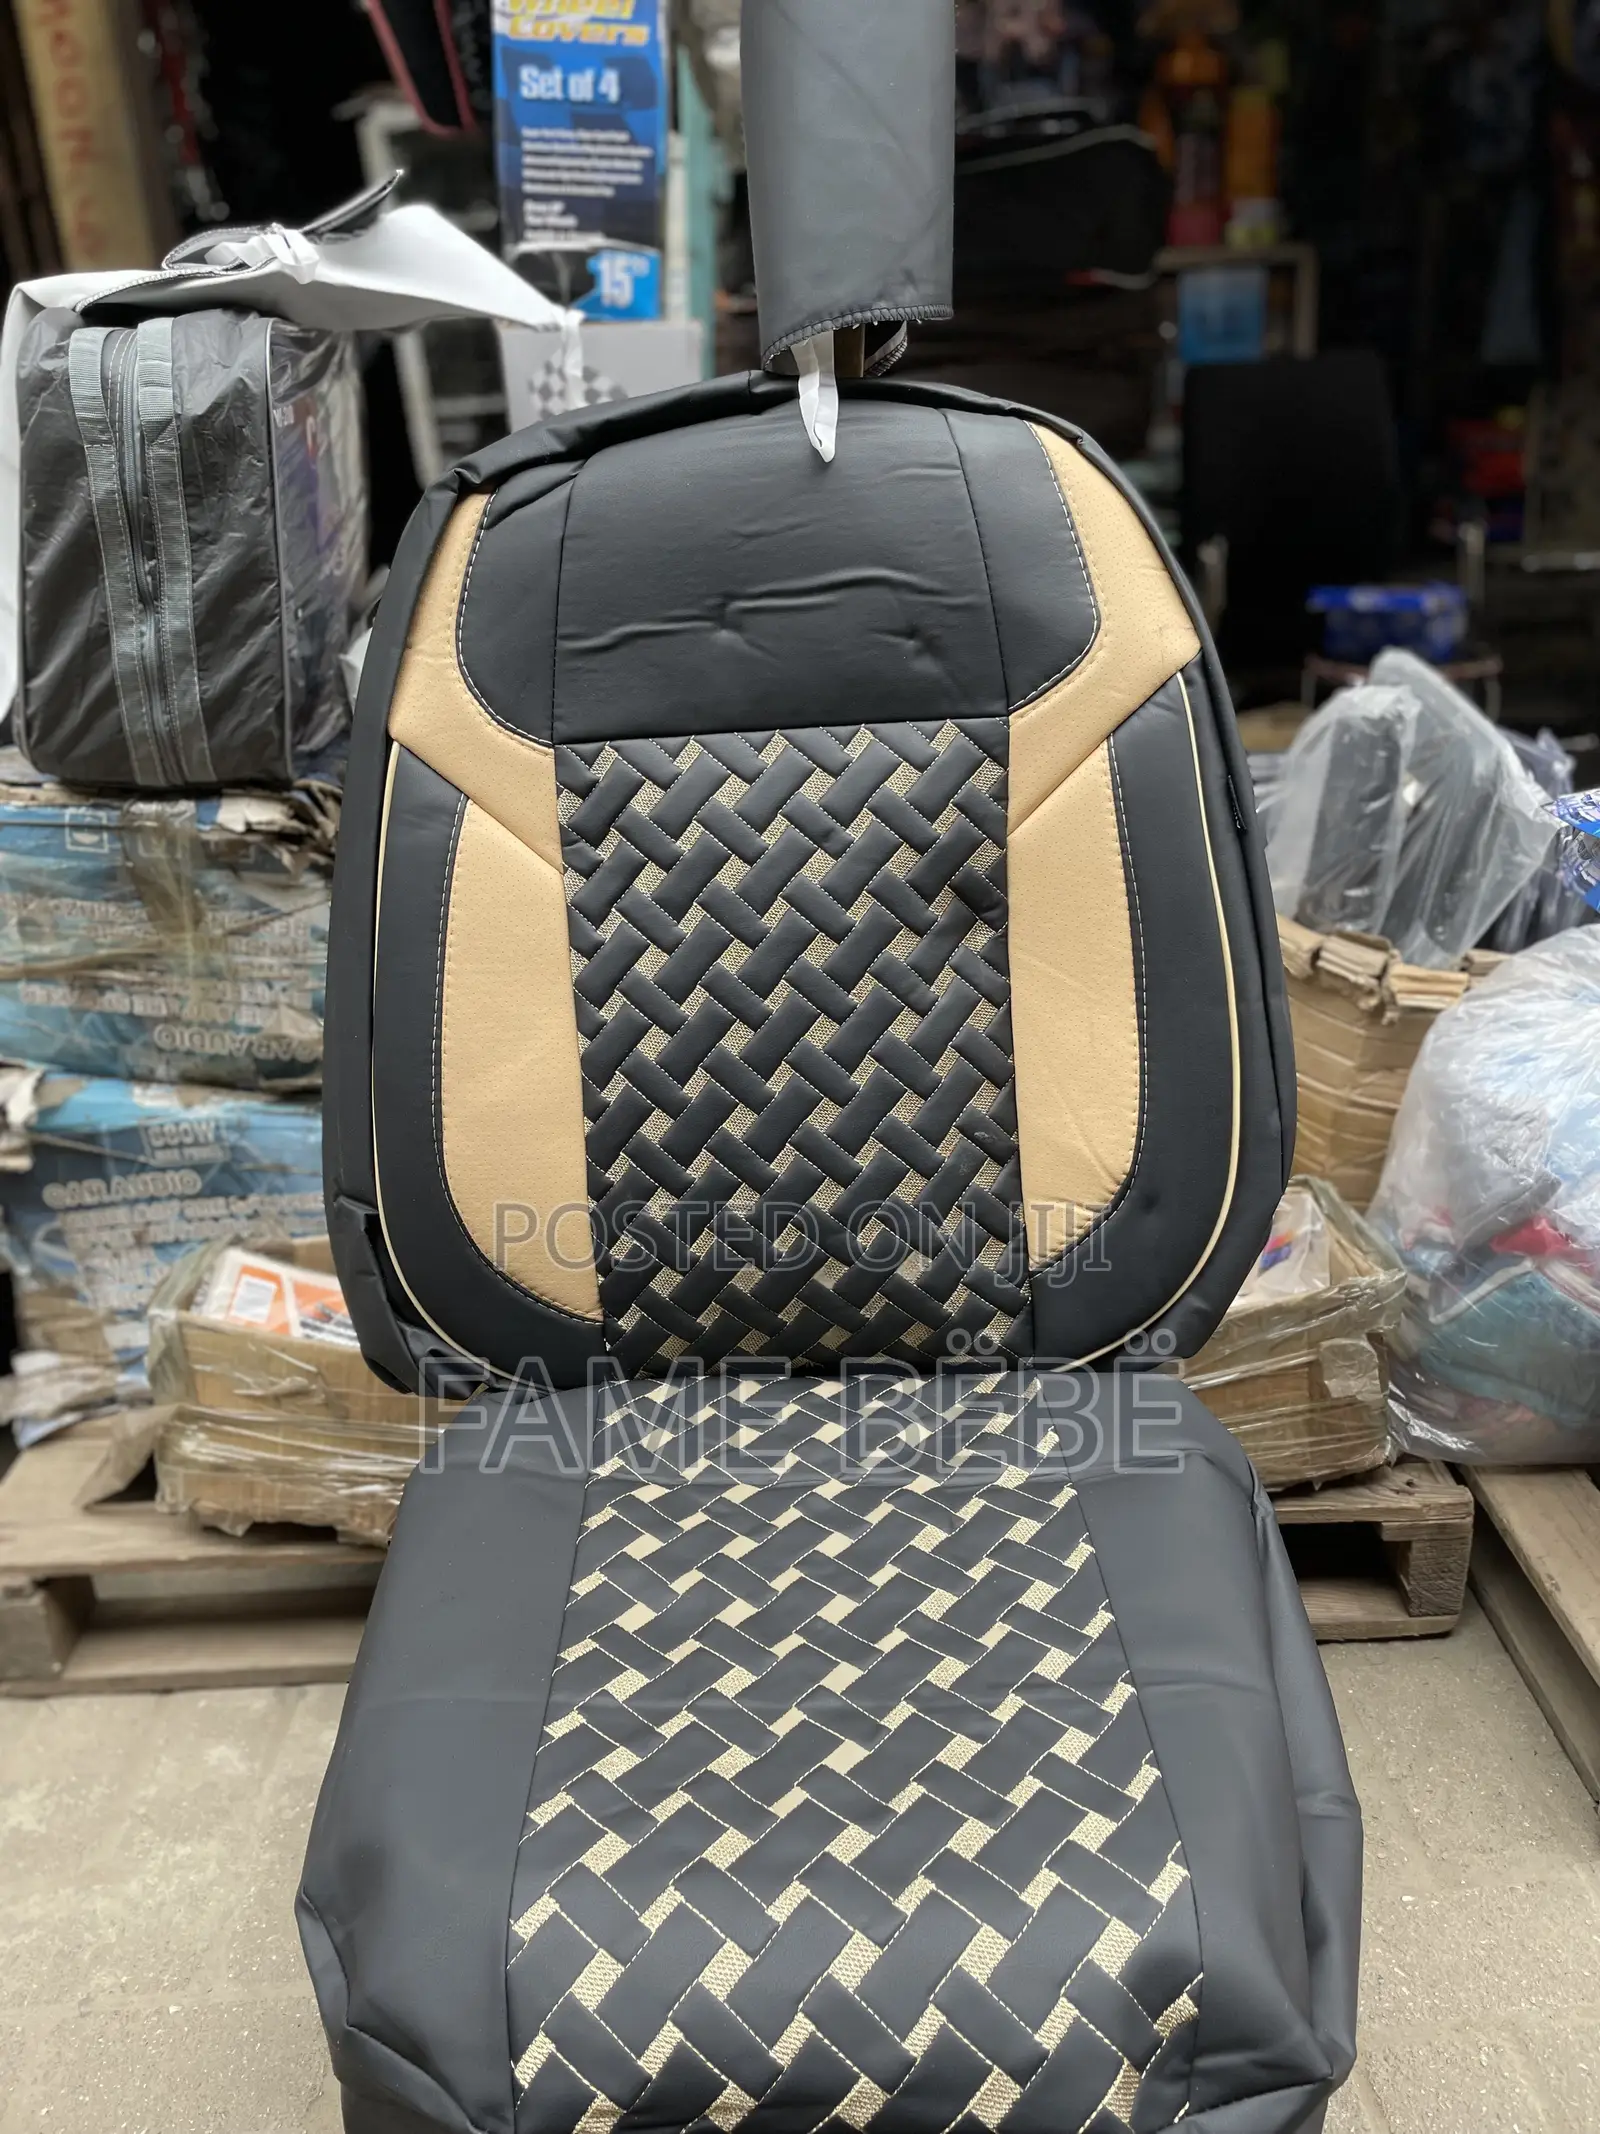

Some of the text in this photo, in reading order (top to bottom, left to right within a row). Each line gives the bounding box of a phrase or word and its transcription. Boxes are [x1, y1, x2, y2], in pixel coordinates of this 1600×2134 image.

[519, 64, 620, 104] Set of 4
